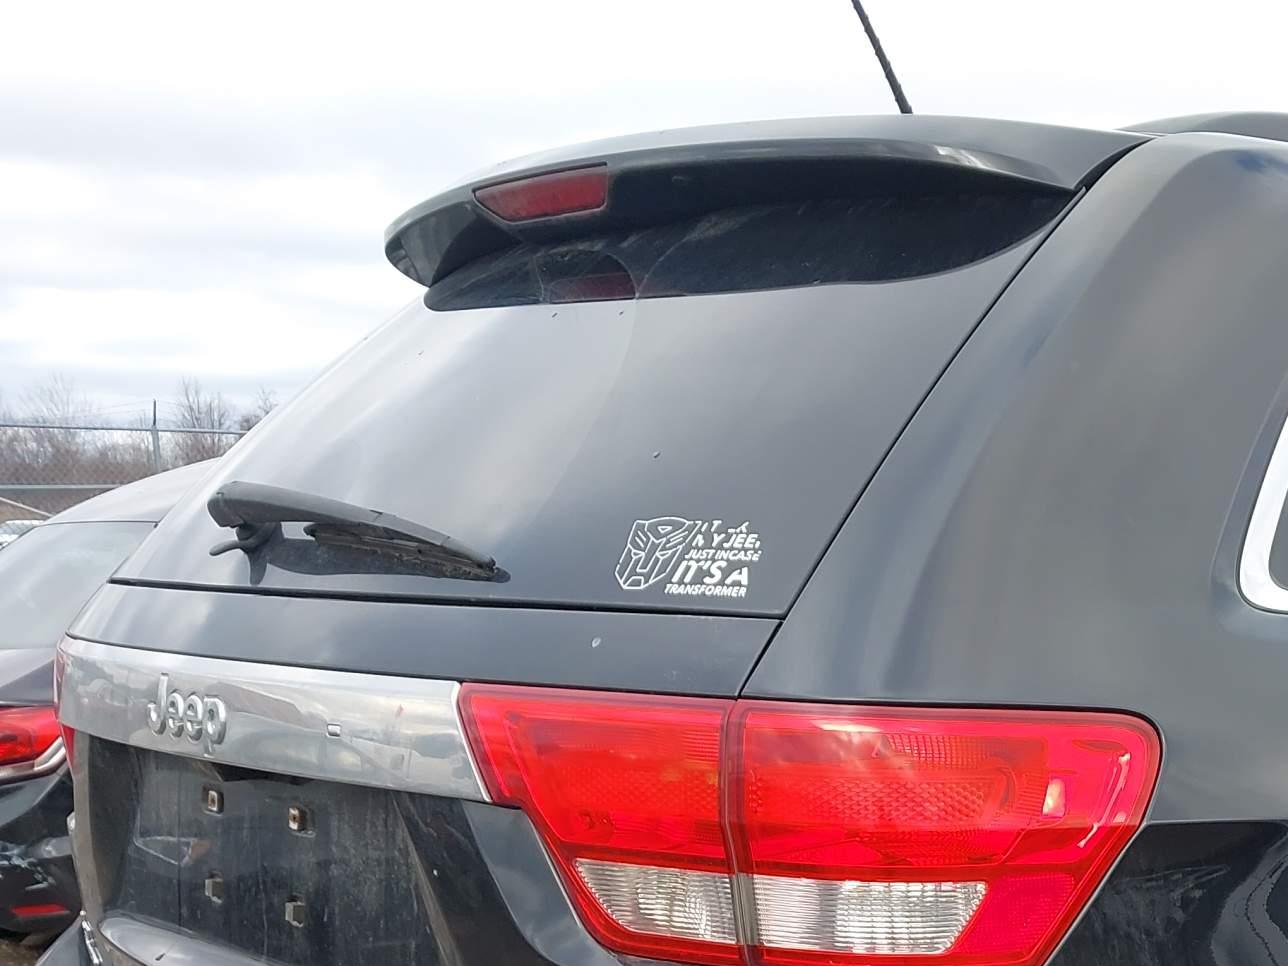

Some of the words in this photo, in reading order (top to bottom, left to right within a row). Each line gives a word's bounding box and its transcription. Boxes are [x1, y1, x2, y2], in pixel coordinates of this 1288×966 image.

[685, 549, 717, 560] JUST
[715, 549, 730, 560] IN
[728, 550, 762, 561] CASE
[671, 560, 728, 584] IT'S
[724, 566, 748, 586] A
[664, 583, 747, 597] TRANSFORMER
[146, 672, 226, 758] Jeep
